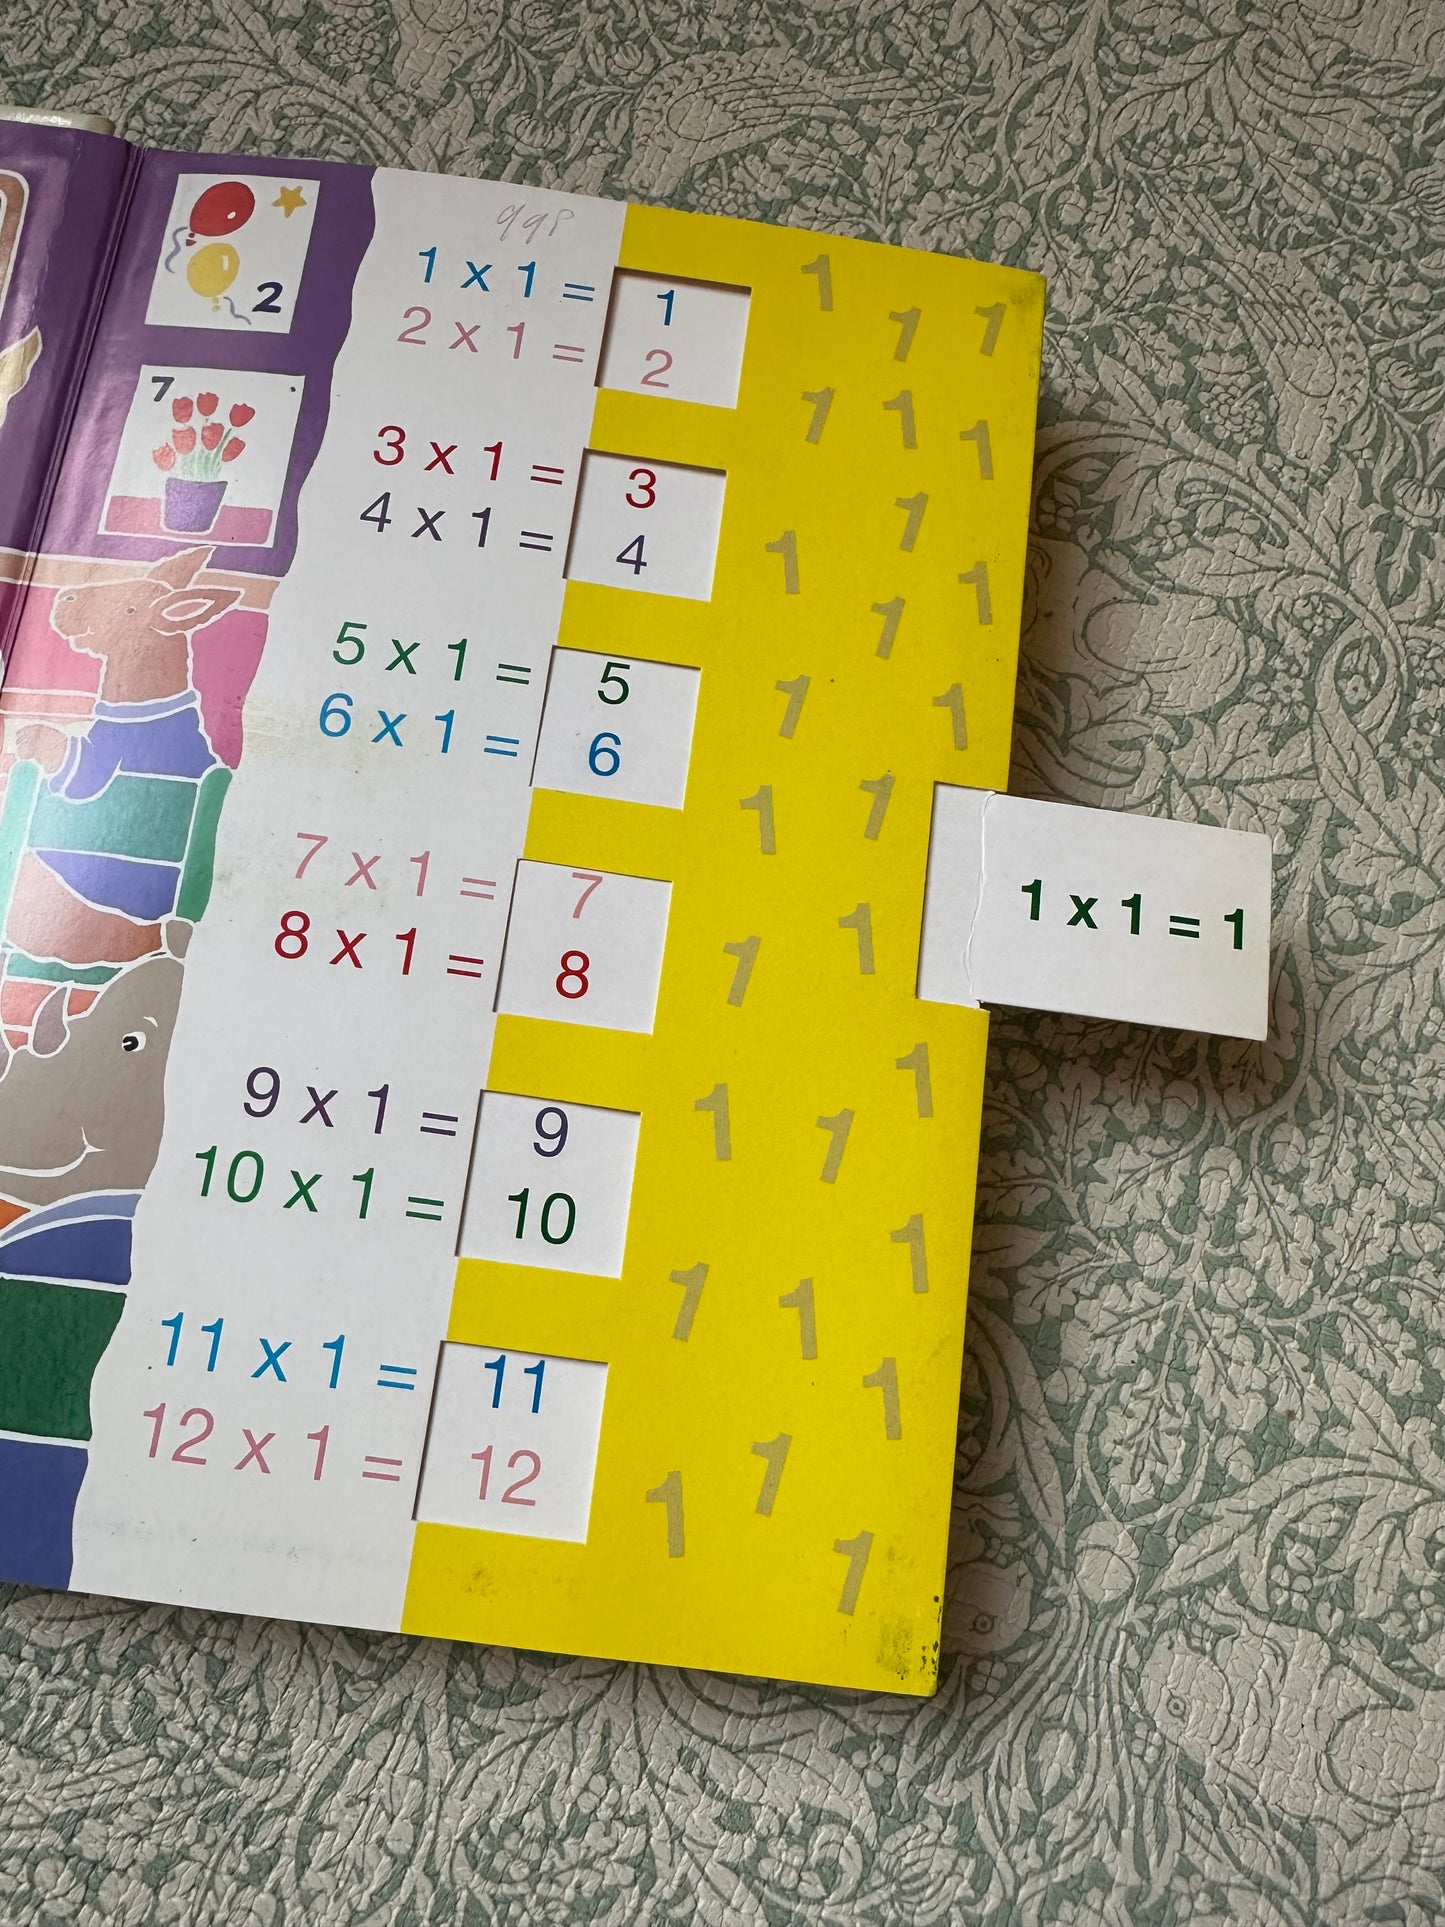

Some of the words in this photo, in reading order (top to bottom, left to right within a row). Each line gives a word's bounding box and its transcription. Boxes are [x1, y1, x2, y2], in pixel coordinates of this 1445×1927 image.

[252, 282, 283, 313] 2
[419, 247, 436, 283] 1
[461, 261, 492, 292] x
[518, 262, 535, 297] 1
[657, 290, 674, 326] 1
[801, 254, 833, 311] 1
[397, 307, 431, 345] 2
[449, 322, 481, 352] x
[507, 322, 525, 359] 1
[641, 349, 672, 388] 2
[888, 306, 922, 363] 1
[974, 302, 1007, 357] 1
[152, 376, 174, 402] 7
[801, 386, 835, 444] 1
[882, 390, 918, 449] 1
[374, 426, 405, 465] 3
[424, 442, 457, 474] x
[484, 442, 502, 480] 1
[626, 469, 656, 508] 3
[960, 420, 994, 480] 1
[360, 492, 391, 532] 4
[411, 508, 445, 541] x
[472, 507, 491, 547] 1
[616, 535, 647, 574] 4
[894, 492, 929, 553] 1
[765, 530, 800, 594] 1
[958, 561, 993, 625] 1
[333, 622, 367, 665] 5
[385, 639, 420, 674] x
[448, 639, 467, 681] 1
[598, 662, 630, 704] 5
[870, 596, 906, 660] 1
[320, 693, 353, 737] 6
[372, 711, 407, 746] x
[435, 710, 454, 753] 1
[589, 732, 621, 776] 6
[775, 675, 811, 739] 1
[933, 683, 968, 751] 1
[740, 785, 776, 855] 1
[859, 774, 895, 841] 1
[295, 832, 328, 879] 7
[344, 852, 381, 890] x
[410, 851, 430, 896] 1
[572, 872, 603, 919] 7
[838, 903, 875, 975] 1
[1022, 879, 1041, 920] 1
[1067, 895, 1098, 929] x
[1122, 894, 1141, 935] 1
[1224, 909, 1243, 950] 1
[275, 911, 310, 959] 8
[330, 930, 367, 968] x
[396, 928, 416, 975] 1
[556, 951, 589, 999] 8
[723, 936, 761, 1007] 1
[244, 1067, 280, 1117] 9
[299, 1086, 338, 1127] x
[368, 1084, 389, 1134] 1
[534, 1107, 568, 1157] 9
[895, 1042, 933, 1118] 1
[694, 1083, 731, 1161] 1
[816, 1108, 855, 1184] 1
[196, 1146, 263, 1202] 10
[283, 1170, 322, 1212] x
[353, 1168, 374, 1219] 1
[508, 1188, 575, 1244] 10
[890, 1213, 929, 1294] 1
[669, 1262, 709, 1343] 1
[779, 1278, 818, 1360] 1
[162, 1312, 223, 1372] 11
[251, 1338, 292, 1382] x
[323, 1335, 345, 1389] 1
[484, 1354, 546, 1413] 11
[863, 1357, 902, 1440] 1
[144, 1403, 214, 1465] 12
[234, 1429, 275, 1474] x
[307, 1425, 329, 1480] 1
[471, 1445, 540, 1506] 12
[751, 1433, 792, 1517] 1
[646, 1471, 685, 1558] 1
[832, 1531, 874, 1616] 1
